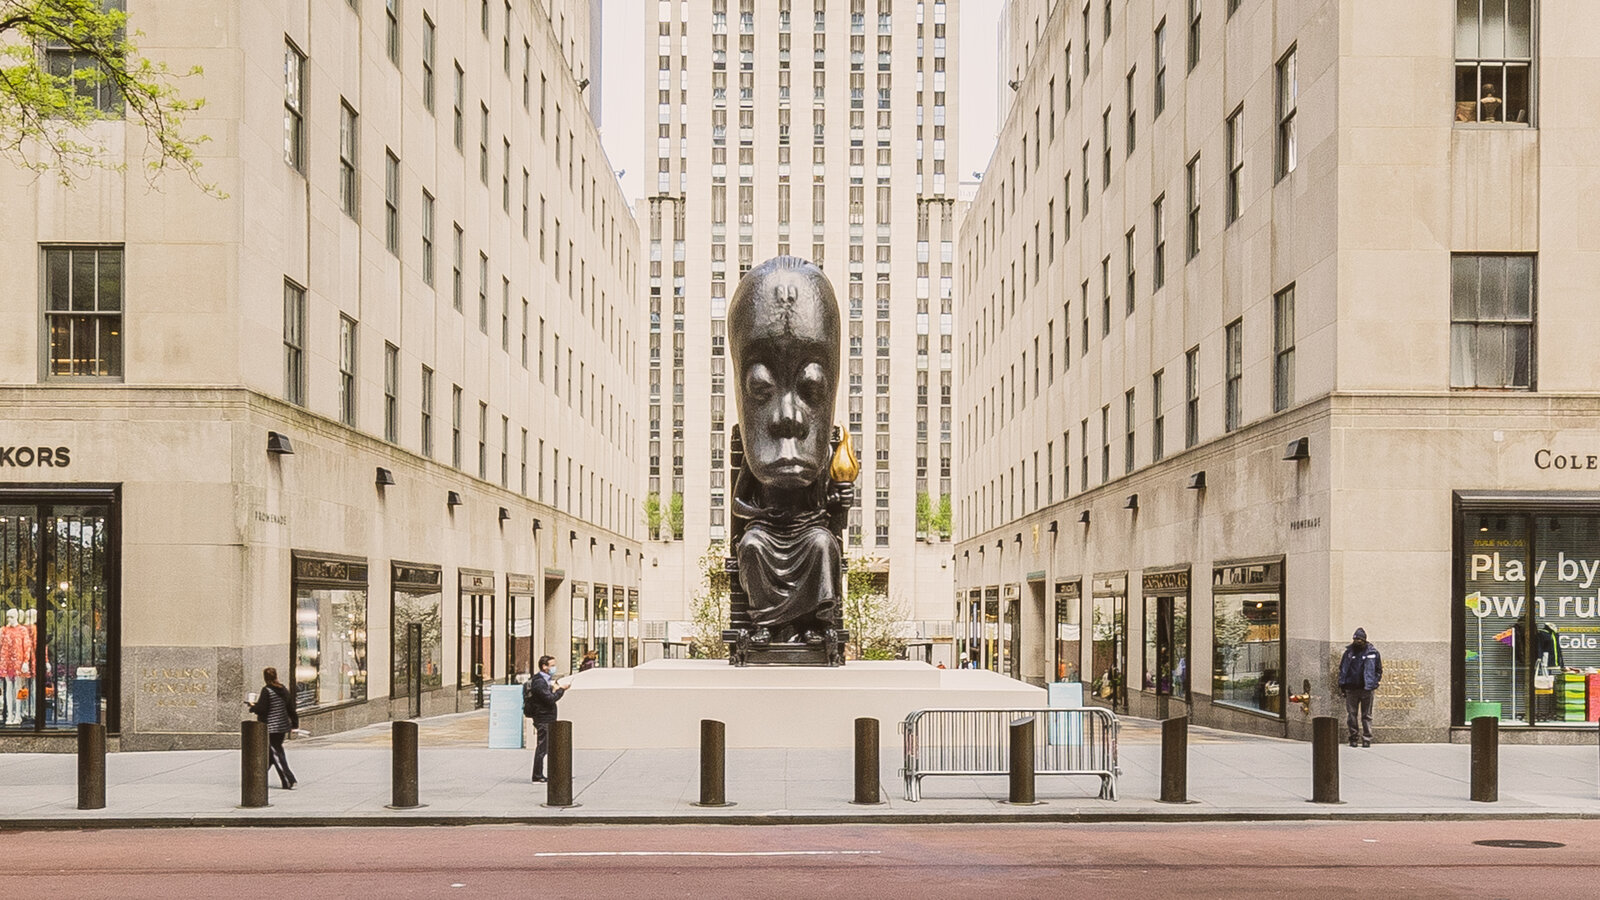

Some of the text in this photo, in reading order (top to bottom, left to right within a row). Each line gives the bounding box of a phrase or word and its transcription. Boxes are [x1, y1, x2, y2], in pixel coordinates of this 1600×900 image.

[0, 446, 70, 468] KORS
[255, 510, 287, 526] PROMENADE
[1290, 516, 1321, 531] PROMENADE
[1558, 552, 1600, 588] by
[1559, 633, 1598, 649] Cole
